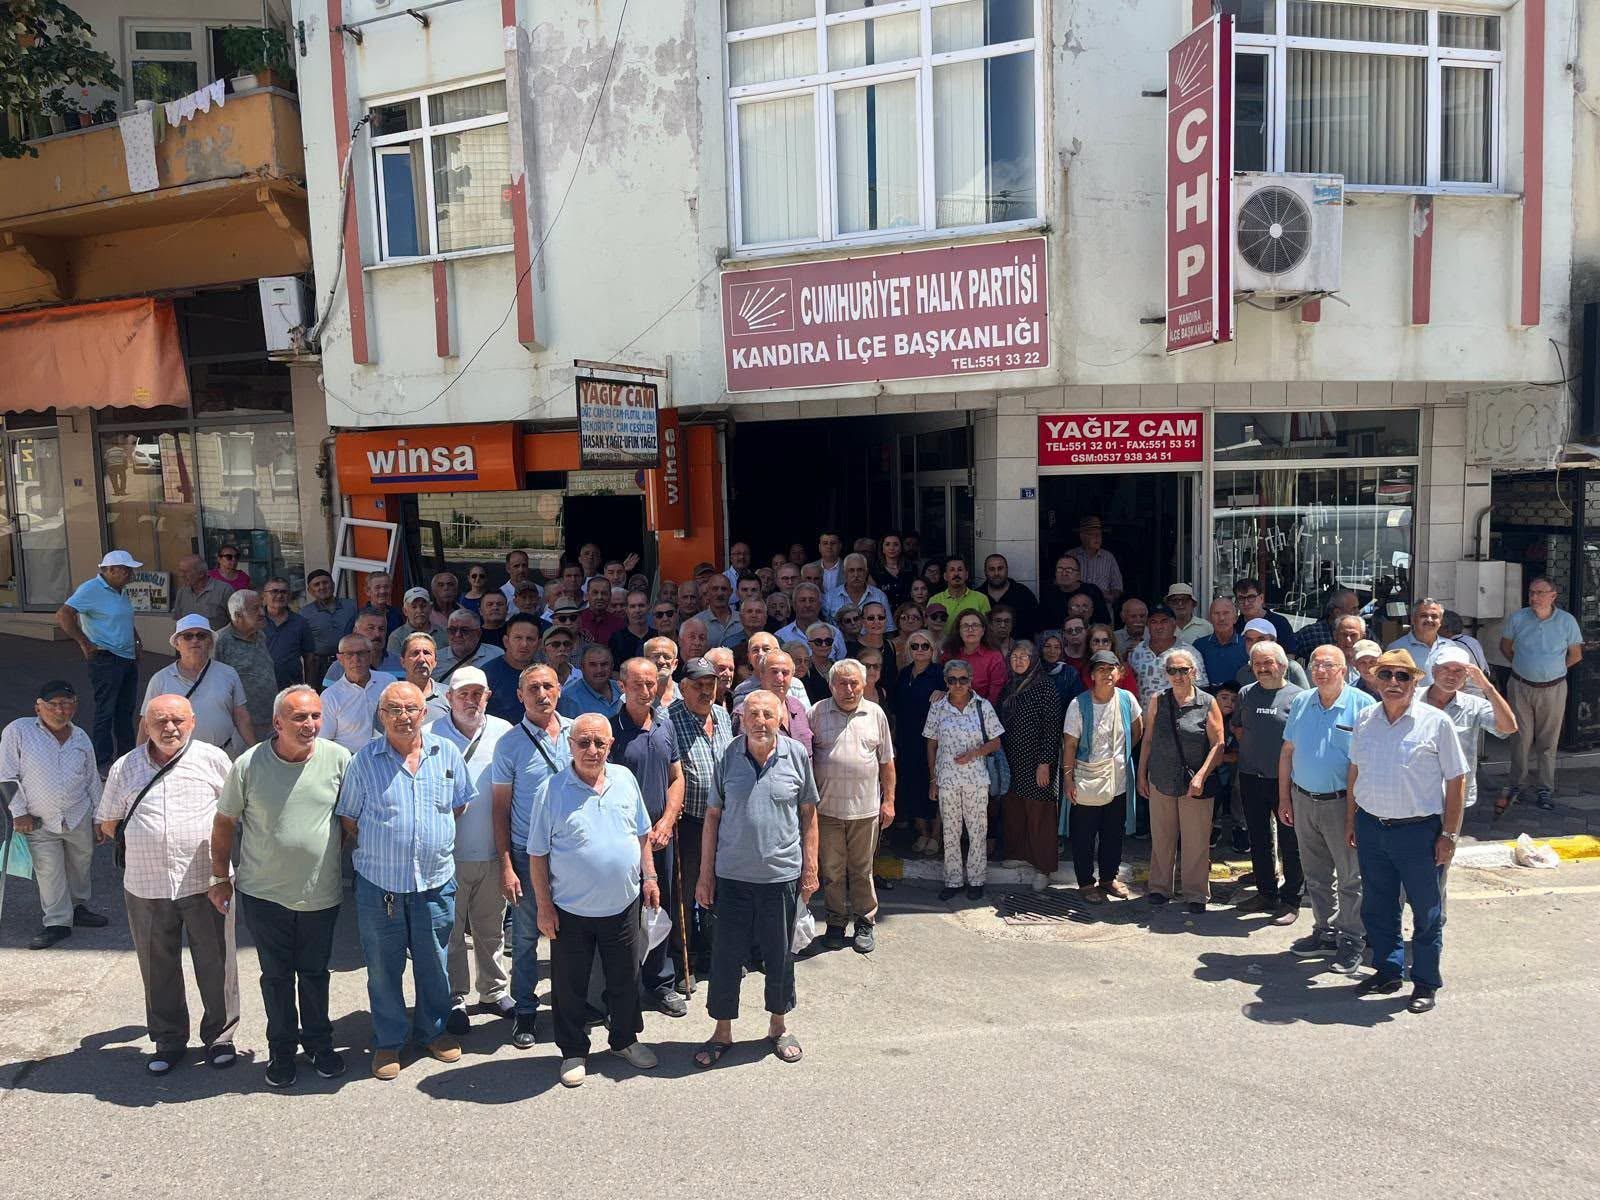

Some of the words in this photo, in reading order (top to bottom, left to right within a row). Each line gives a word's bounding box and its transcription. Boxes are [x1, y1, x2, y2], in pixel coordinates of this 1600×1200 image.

[1176, 107, 1208, 297] CHP
[800, 271, 911, 326] CUMHURİYET
[916, 271, 964, 315] HALK
[969, 254, 1038, 309] PARTİSİ
[732, 340, 830, 370] KANDIRA
[837, 329, 887, 365] İLÇE
[894, 317, 1040, 359] BAŞKANLIĞI
[951, 355, 1001, 371] TEL:551
[1006, 353, 1021, 366] 33
[1024, 351, 1040, 364] 22
[626, 388, 655, 409] CAM
[1045, 416, 1130, 439] YAĞIZ
[1138, 419, 1197, 437] CAM
[583, 434, 604, 449] HASAN
[1046, 441, 1087, 452] TEL:551
[1090, 441, 1103, 450] 32
[1105, 441, 1118, 450] 01
[1126, 440, 1167, 449] FAX:551
[1169, 440, 1182, 449] 53
[1184, 439, 1196, 448] 51
[367, 440, 474, 474] winsa
[664, 428, 679, 505] winsa
[1071, 453, 1121, 463] GSM:0537
[1124, 452, 1143, 462] 938
[1145, 452, 1158, 461] 34
[1160, 452, 1172, 461] 51
[1256, 707, 1278, 715] mavi
